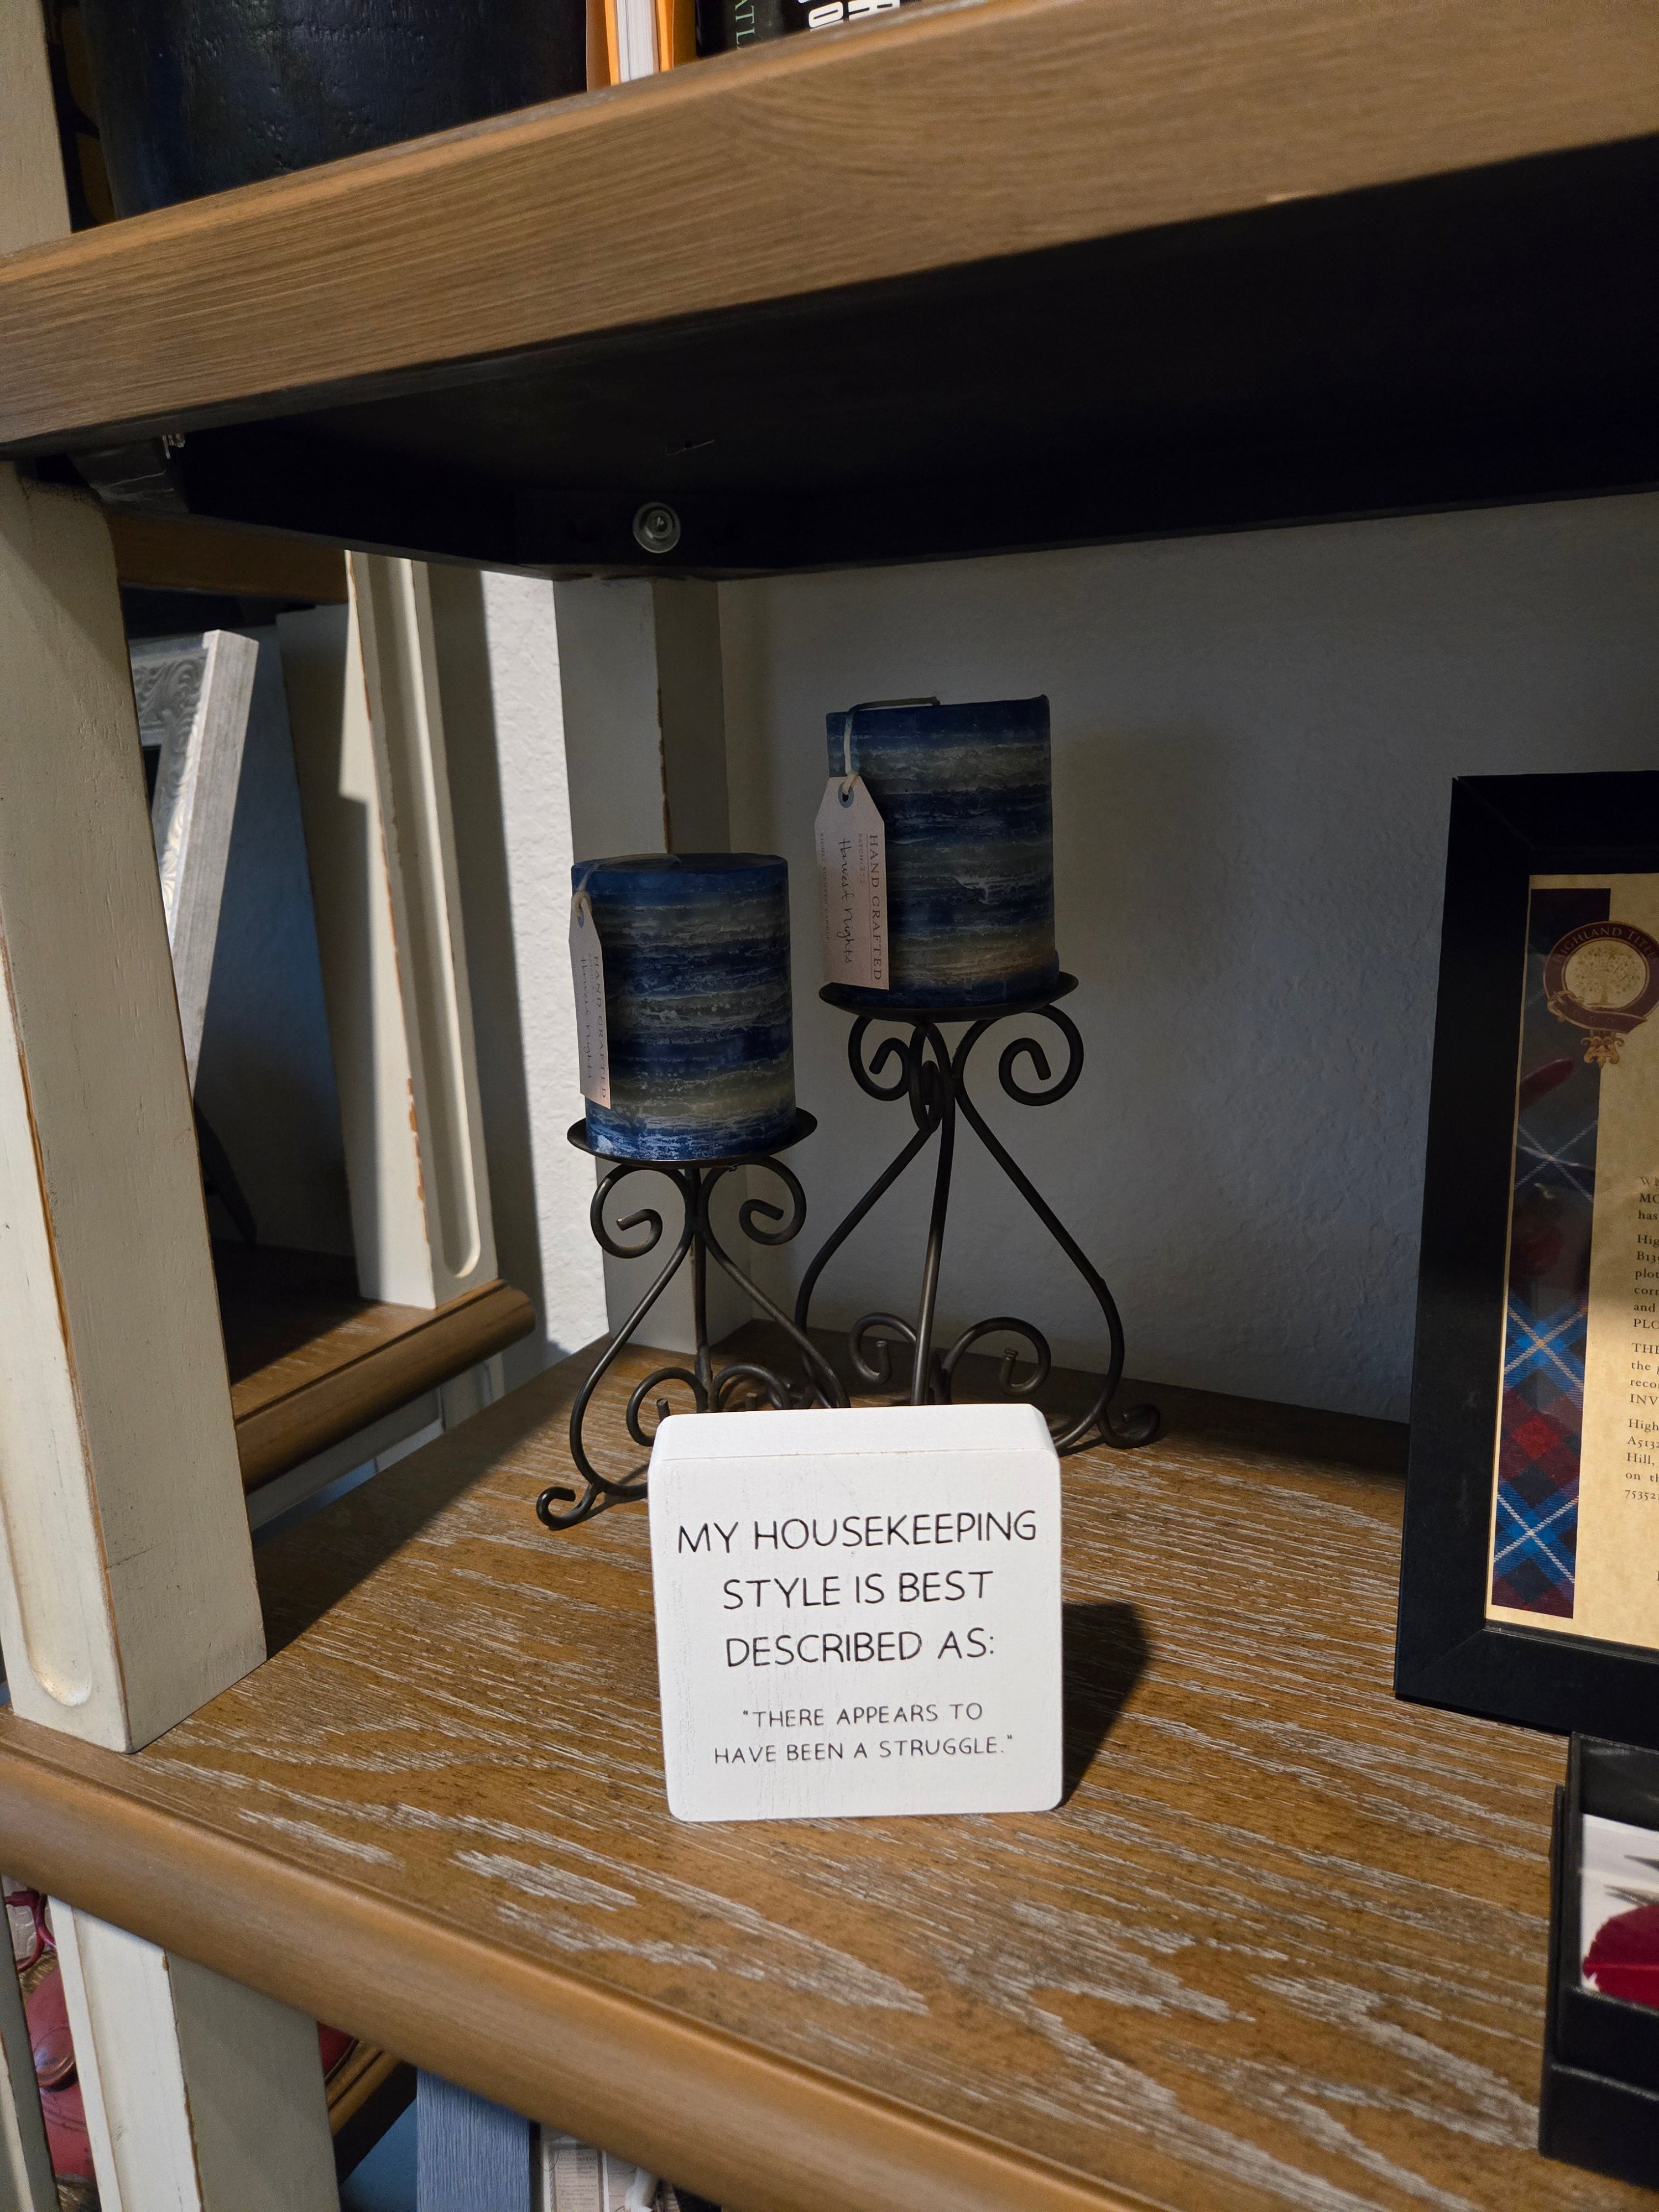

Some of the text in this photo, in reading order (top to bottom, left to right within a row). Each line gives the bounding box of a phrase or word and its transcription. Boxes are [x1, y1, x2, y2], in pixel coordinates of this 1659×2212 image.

[870, 834, 881, 980] HAND CRAFTED
[1553, 927, 1623, 963] HIGHLAND
[1638, 1210, 1657, 1220] has
[1637, 1250, 1659, 1264] B13
[1634, 1303, 1655, 1312] and
[1631, 1360, 1651, 1371] the
[1630, 1380, 1659, 1389] reco
[1630, 1394, 1659, 1406] INV
[1628, 1418, 1659, 1433] High
[1627, 1452, 1655, 1466] Hill,
[1625, 1472, 1641, 1481] on
[1625, 1490, 1659, 1501] 75352
[678, 1509, 1037, 1554] MY HOUSEKEEPING
[723, 1569, 994, 1610] STYLE IS BEST
[726, 1627, 994, 1668] DESCRIBED AS:
[743, 1702, 983, 1728] "THERE APPEARS TO
[714, 1734, 1013, 1764] HAVE BEEN A STRUGGLE."
